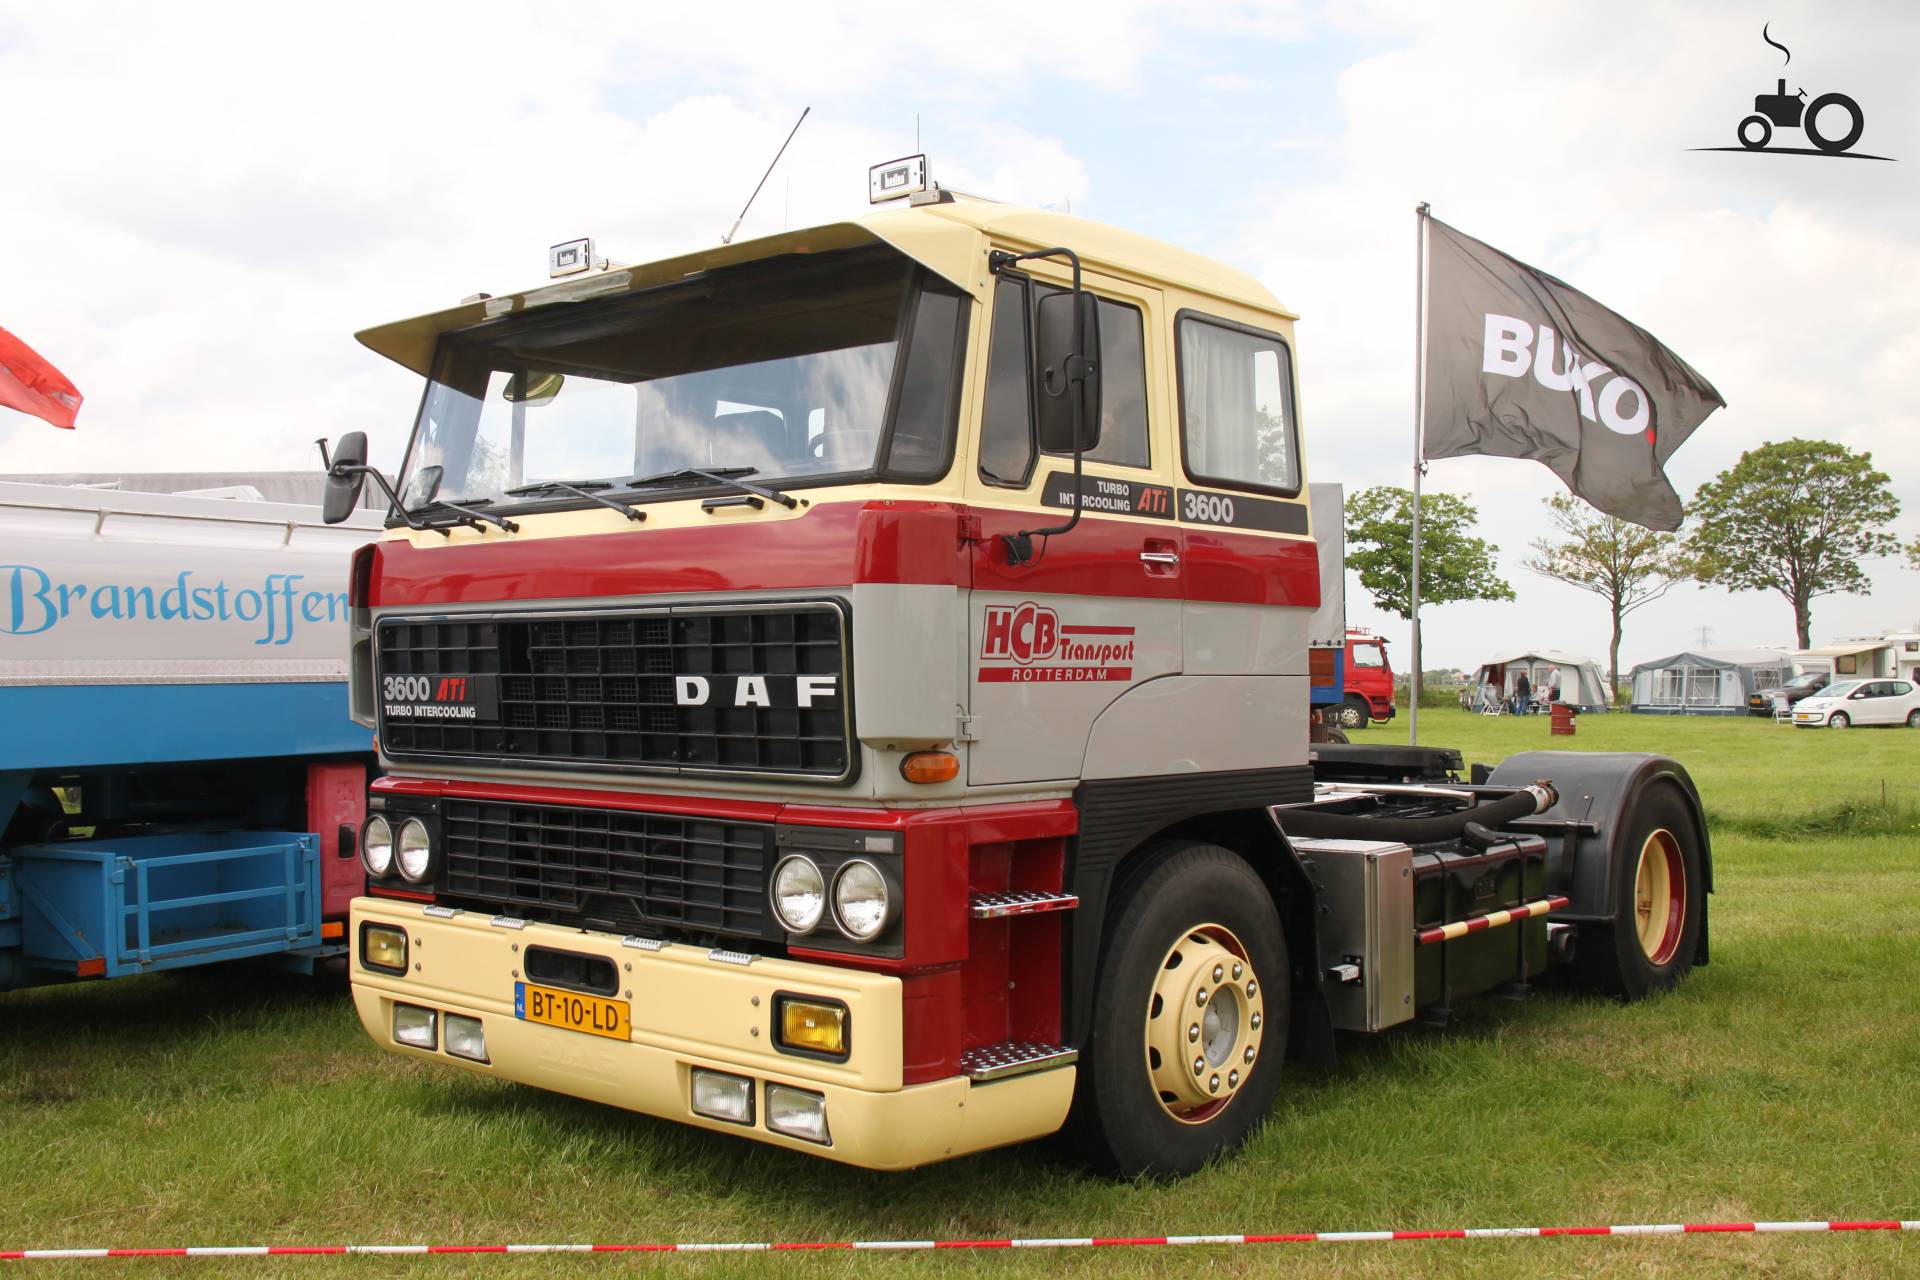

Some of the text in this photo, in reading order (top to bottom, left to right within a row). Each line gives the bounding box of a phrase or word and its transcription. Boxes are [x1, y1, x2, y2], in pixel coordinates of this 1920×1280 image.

[1059, 492, 1131, 512] INTRCOOLING
[1097, 480, 1130, 497] TURBO
[1184, 492, 1234, 524] 3600
[0, 565, 349, 645] Brandstoffen
[983, 605, 1057, 661] HCB
[1059, 638, 1134, 666] Transport
[383, 676, 430, 702] 3600
[1011, 669, 1108, 681] ROTTERDAM
[675, 676, 837, 708] DAF
[385, 704, 476, 718] TURBO INTERCOOLING
[532, 990, 619, 1032] BT-10-LD
